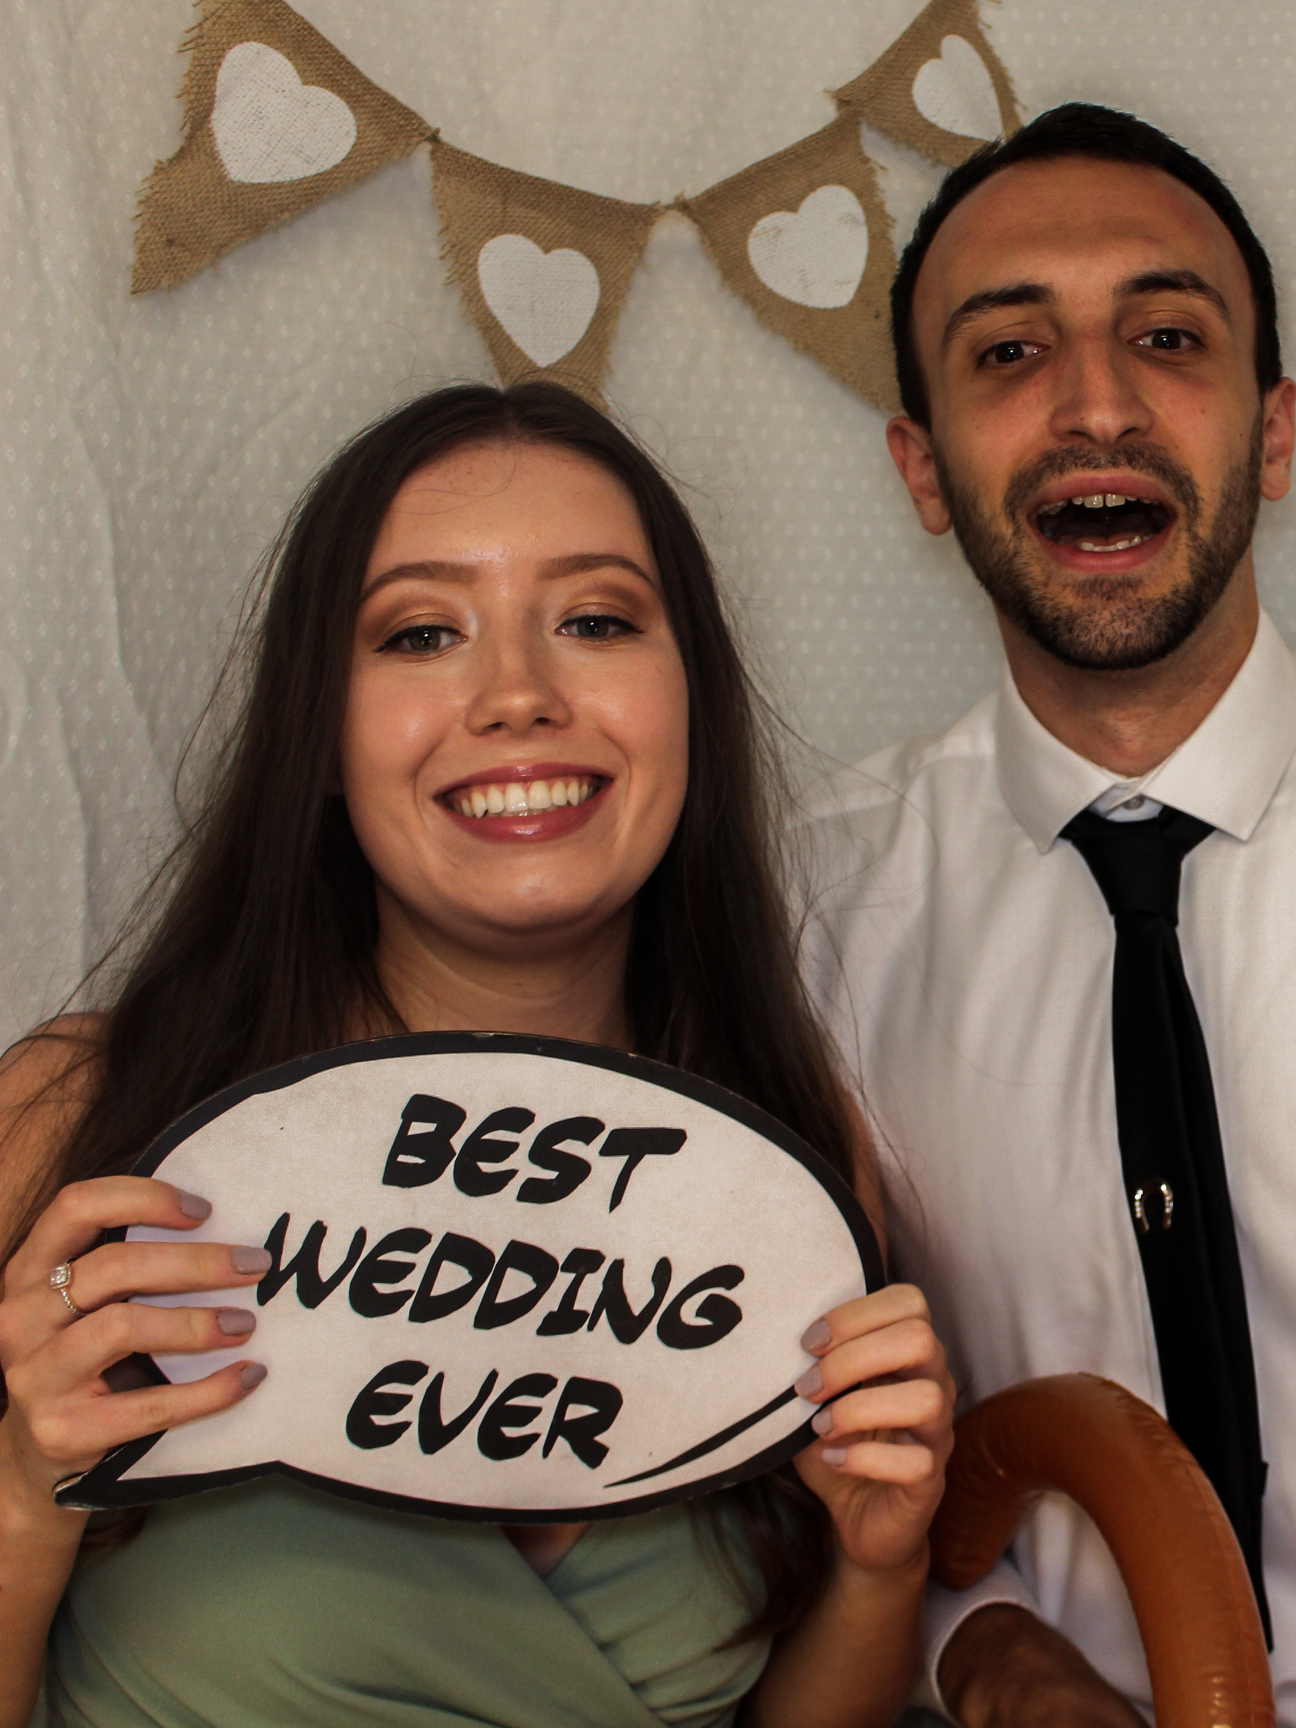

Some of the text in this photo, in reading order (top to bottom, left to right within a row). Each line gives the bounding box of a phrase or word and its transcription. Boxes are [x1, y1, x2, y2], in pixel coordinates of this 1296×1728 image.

[381, 1093, 688, 1213] BEST
[257, 1212, 745, 1351] WEDDING
[345, 1360, 624, 1470] EVER
